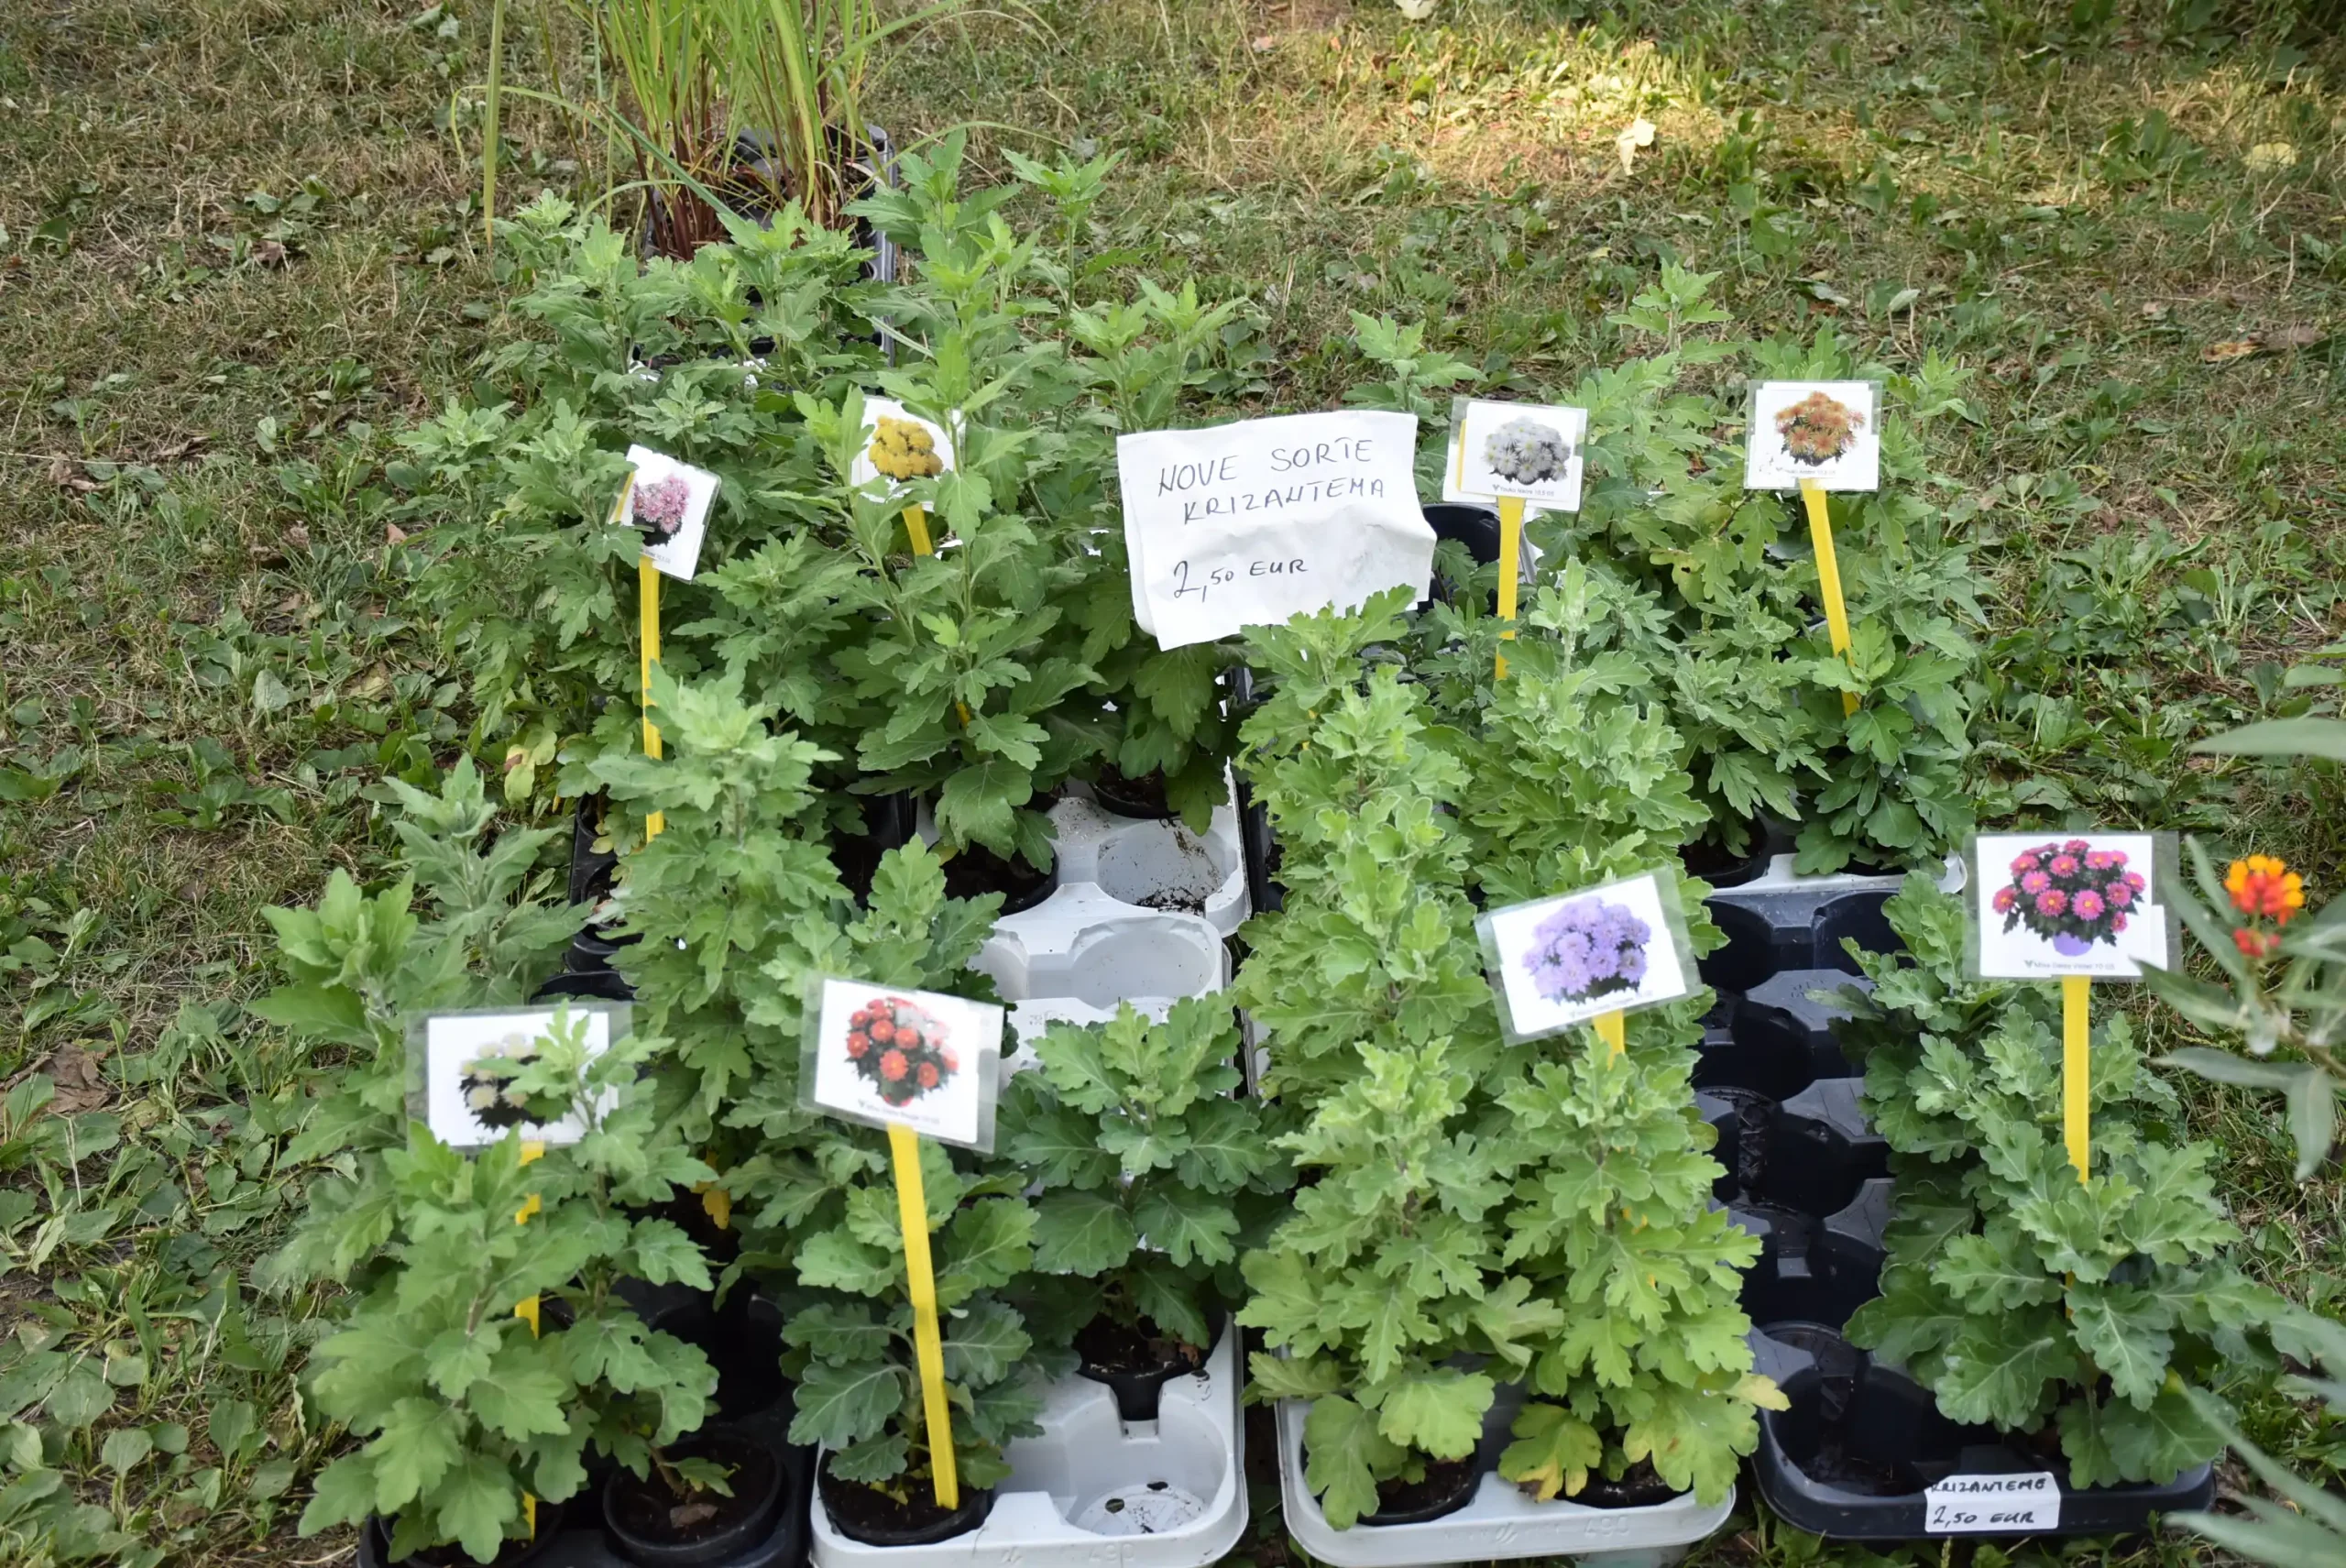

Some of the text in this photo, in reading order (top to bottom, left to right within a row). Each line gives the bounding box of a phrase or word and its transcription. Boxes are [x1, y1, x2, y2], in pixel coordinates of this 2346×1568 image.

[1158, 436, 1373, 497] NOVE SORTE
[1184, 477, 1384, 525] KRIZANTEMA
[1173, 558, 1308, 602] 2,50 EUR
[1933, 1505, 2034, 1529] 2,50 EUR
